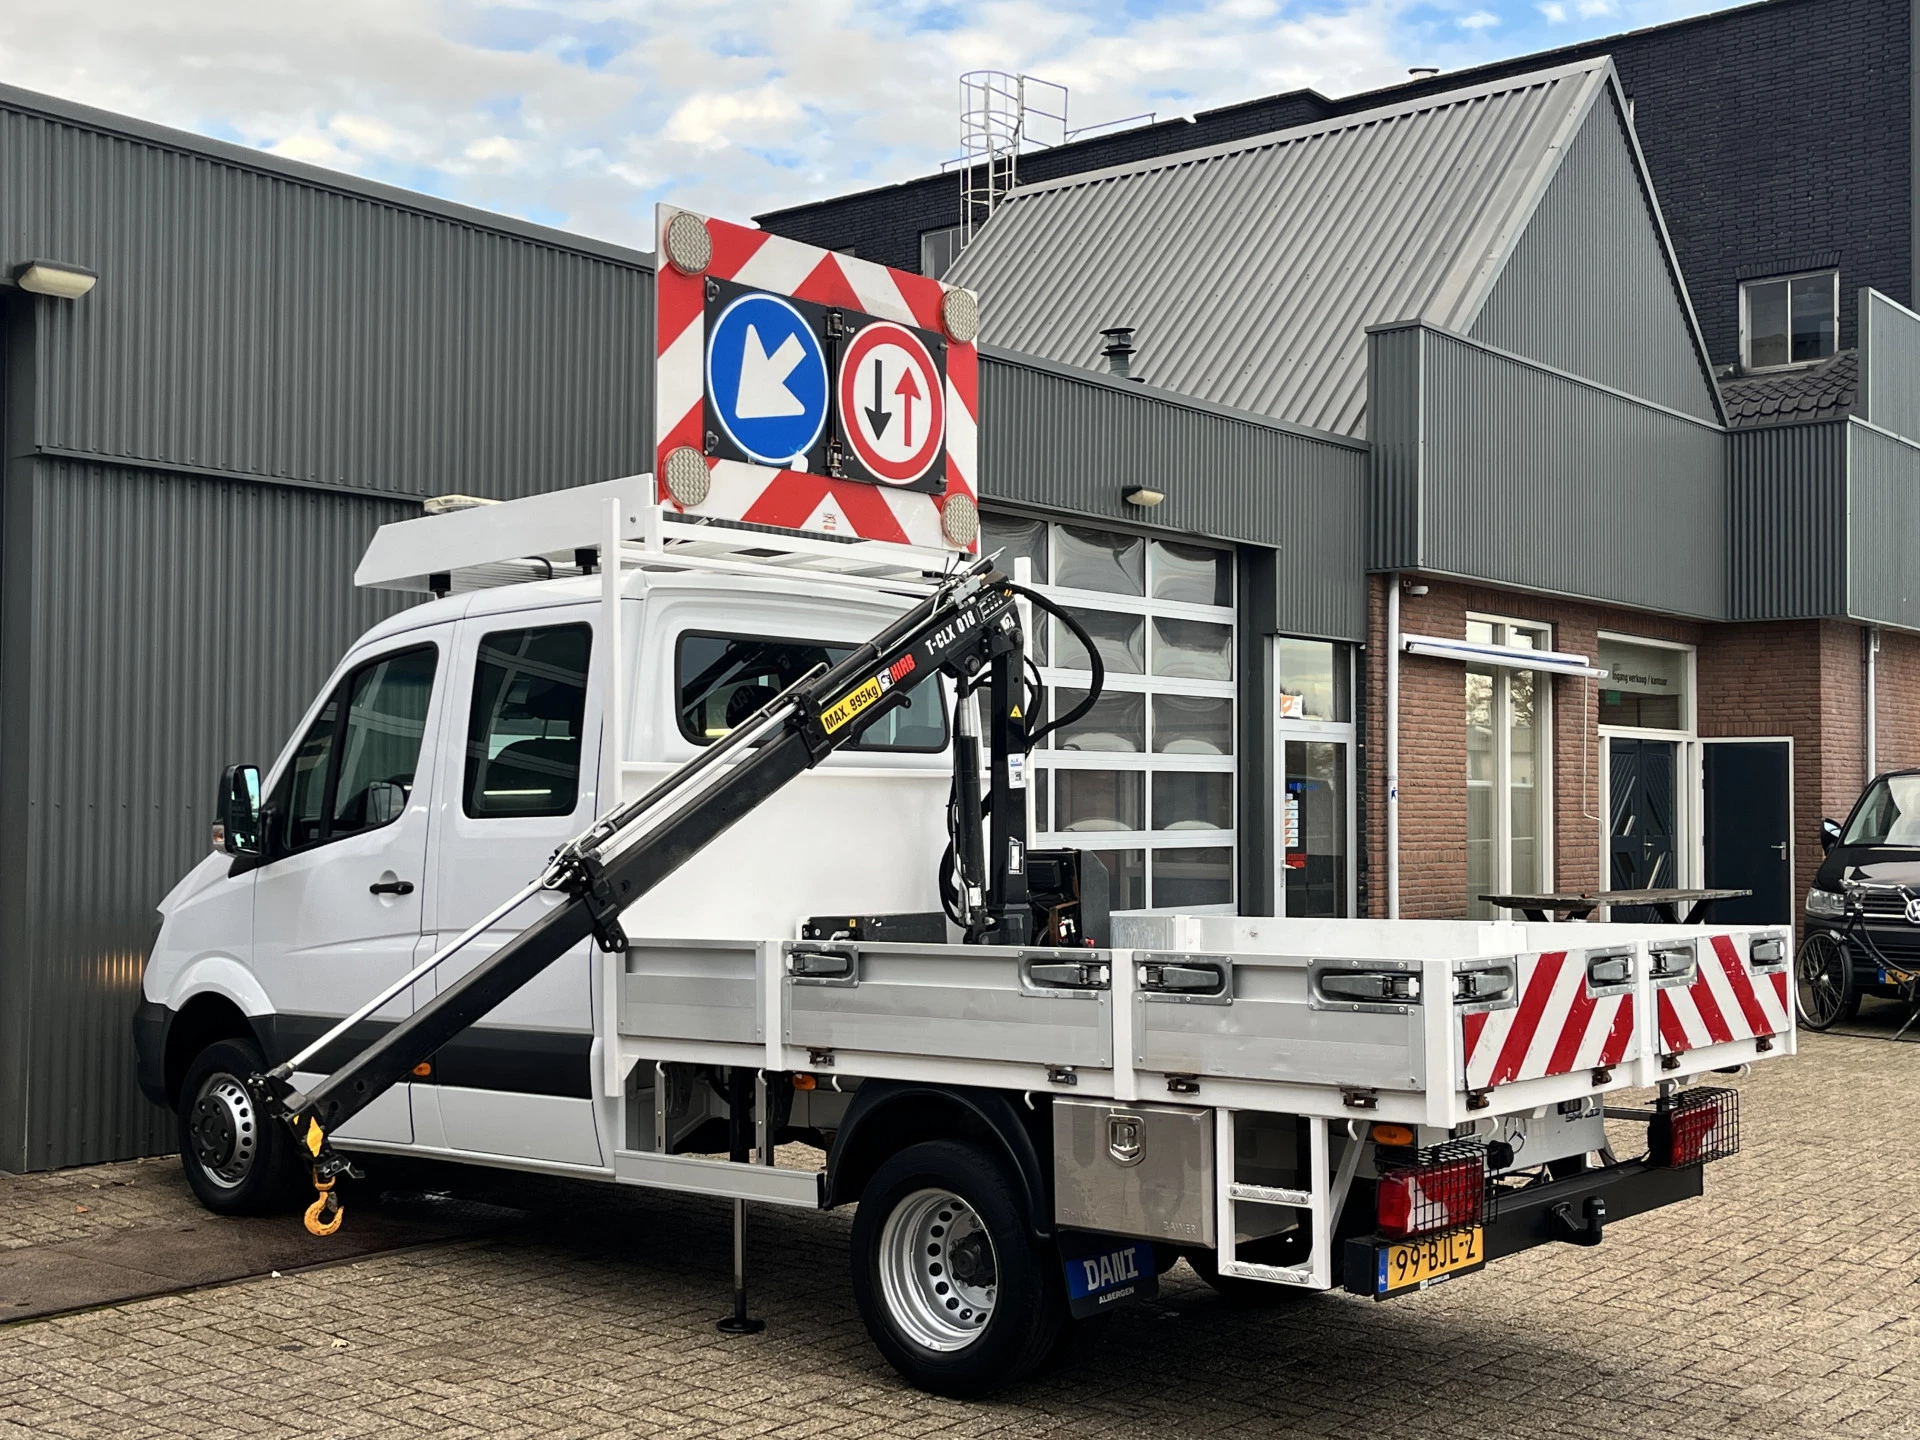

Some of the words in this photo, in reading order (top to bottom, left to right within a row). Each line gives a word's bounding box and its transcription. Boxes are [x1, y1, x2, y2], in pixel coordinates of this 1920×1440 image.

[925, 624, 956, 655] T-CLX
[956, 610, 976, 633] 018
[890, 653, 916, 682] HIAB
[1612, 669, 1628, 684] Ingang
[1628, 673, 1647, 686] verkoop
[824, 705, 850, 730] MAX.
[849, 685, 879, 711] 995kg
[1083, 1247, 1139, 1291] DANI
[1396, 1231, 1476, 1281] 99-BJL-2
[1098, 1286, 1135, 1304] ALBERGEN
[1378, 1274, 1387, 1285] NL
